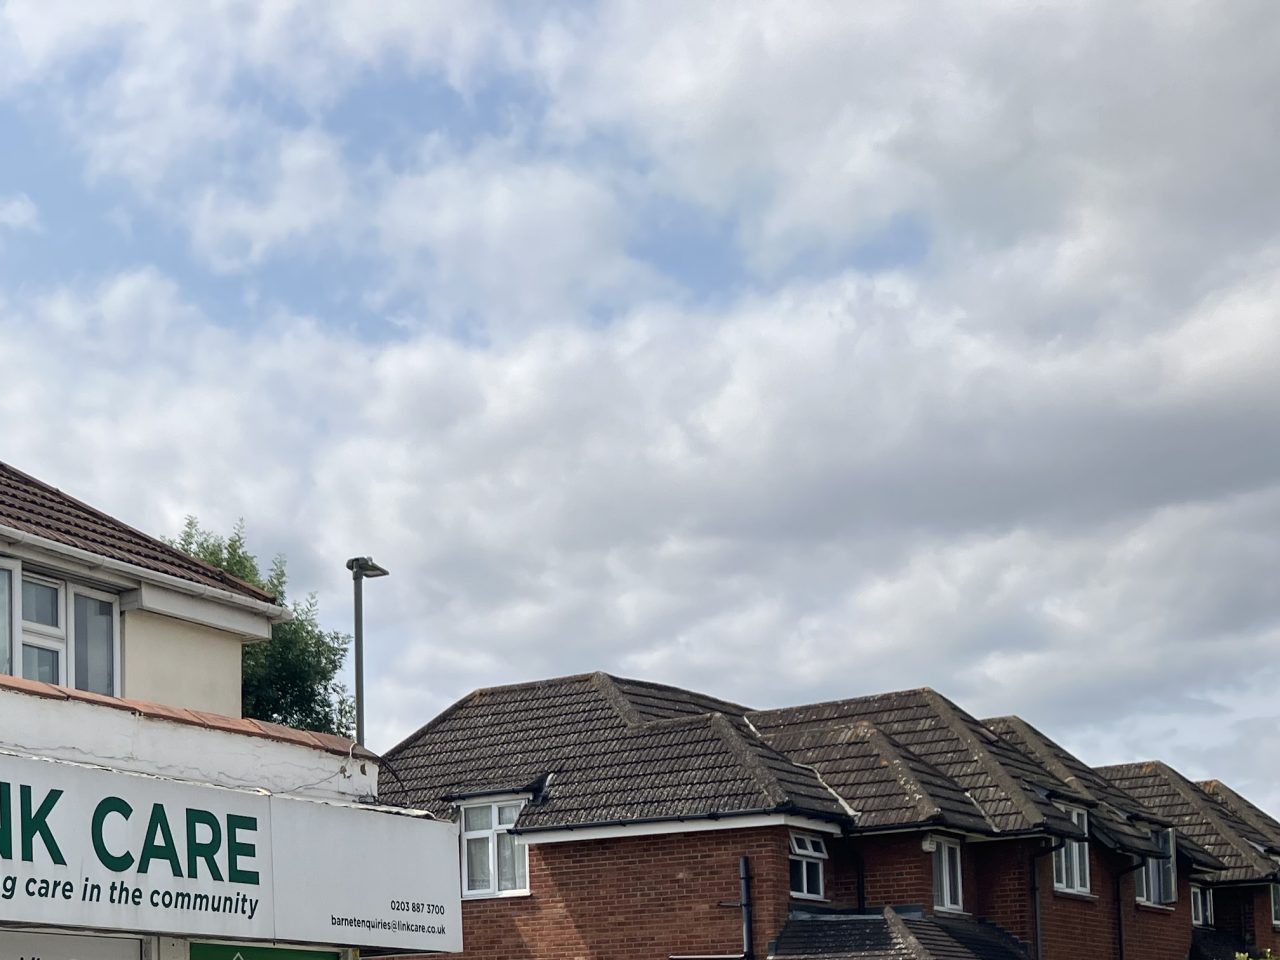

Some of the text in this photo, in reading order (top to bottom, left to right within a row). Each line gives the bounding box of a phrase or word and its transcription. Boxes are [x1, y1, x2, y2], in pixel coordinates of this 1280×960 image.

[91, 796, 260, 885] CARE
[25, 875, 73, 900] care
[82, 877, 102, 902] in
[109, 881, 143, 906] the
[149, 887, 258, 920] community
[390, 900, 445, 916] 0203 887 3700
[331, 914, 446, 935] barnetenquiries@linkcare.co.uk
